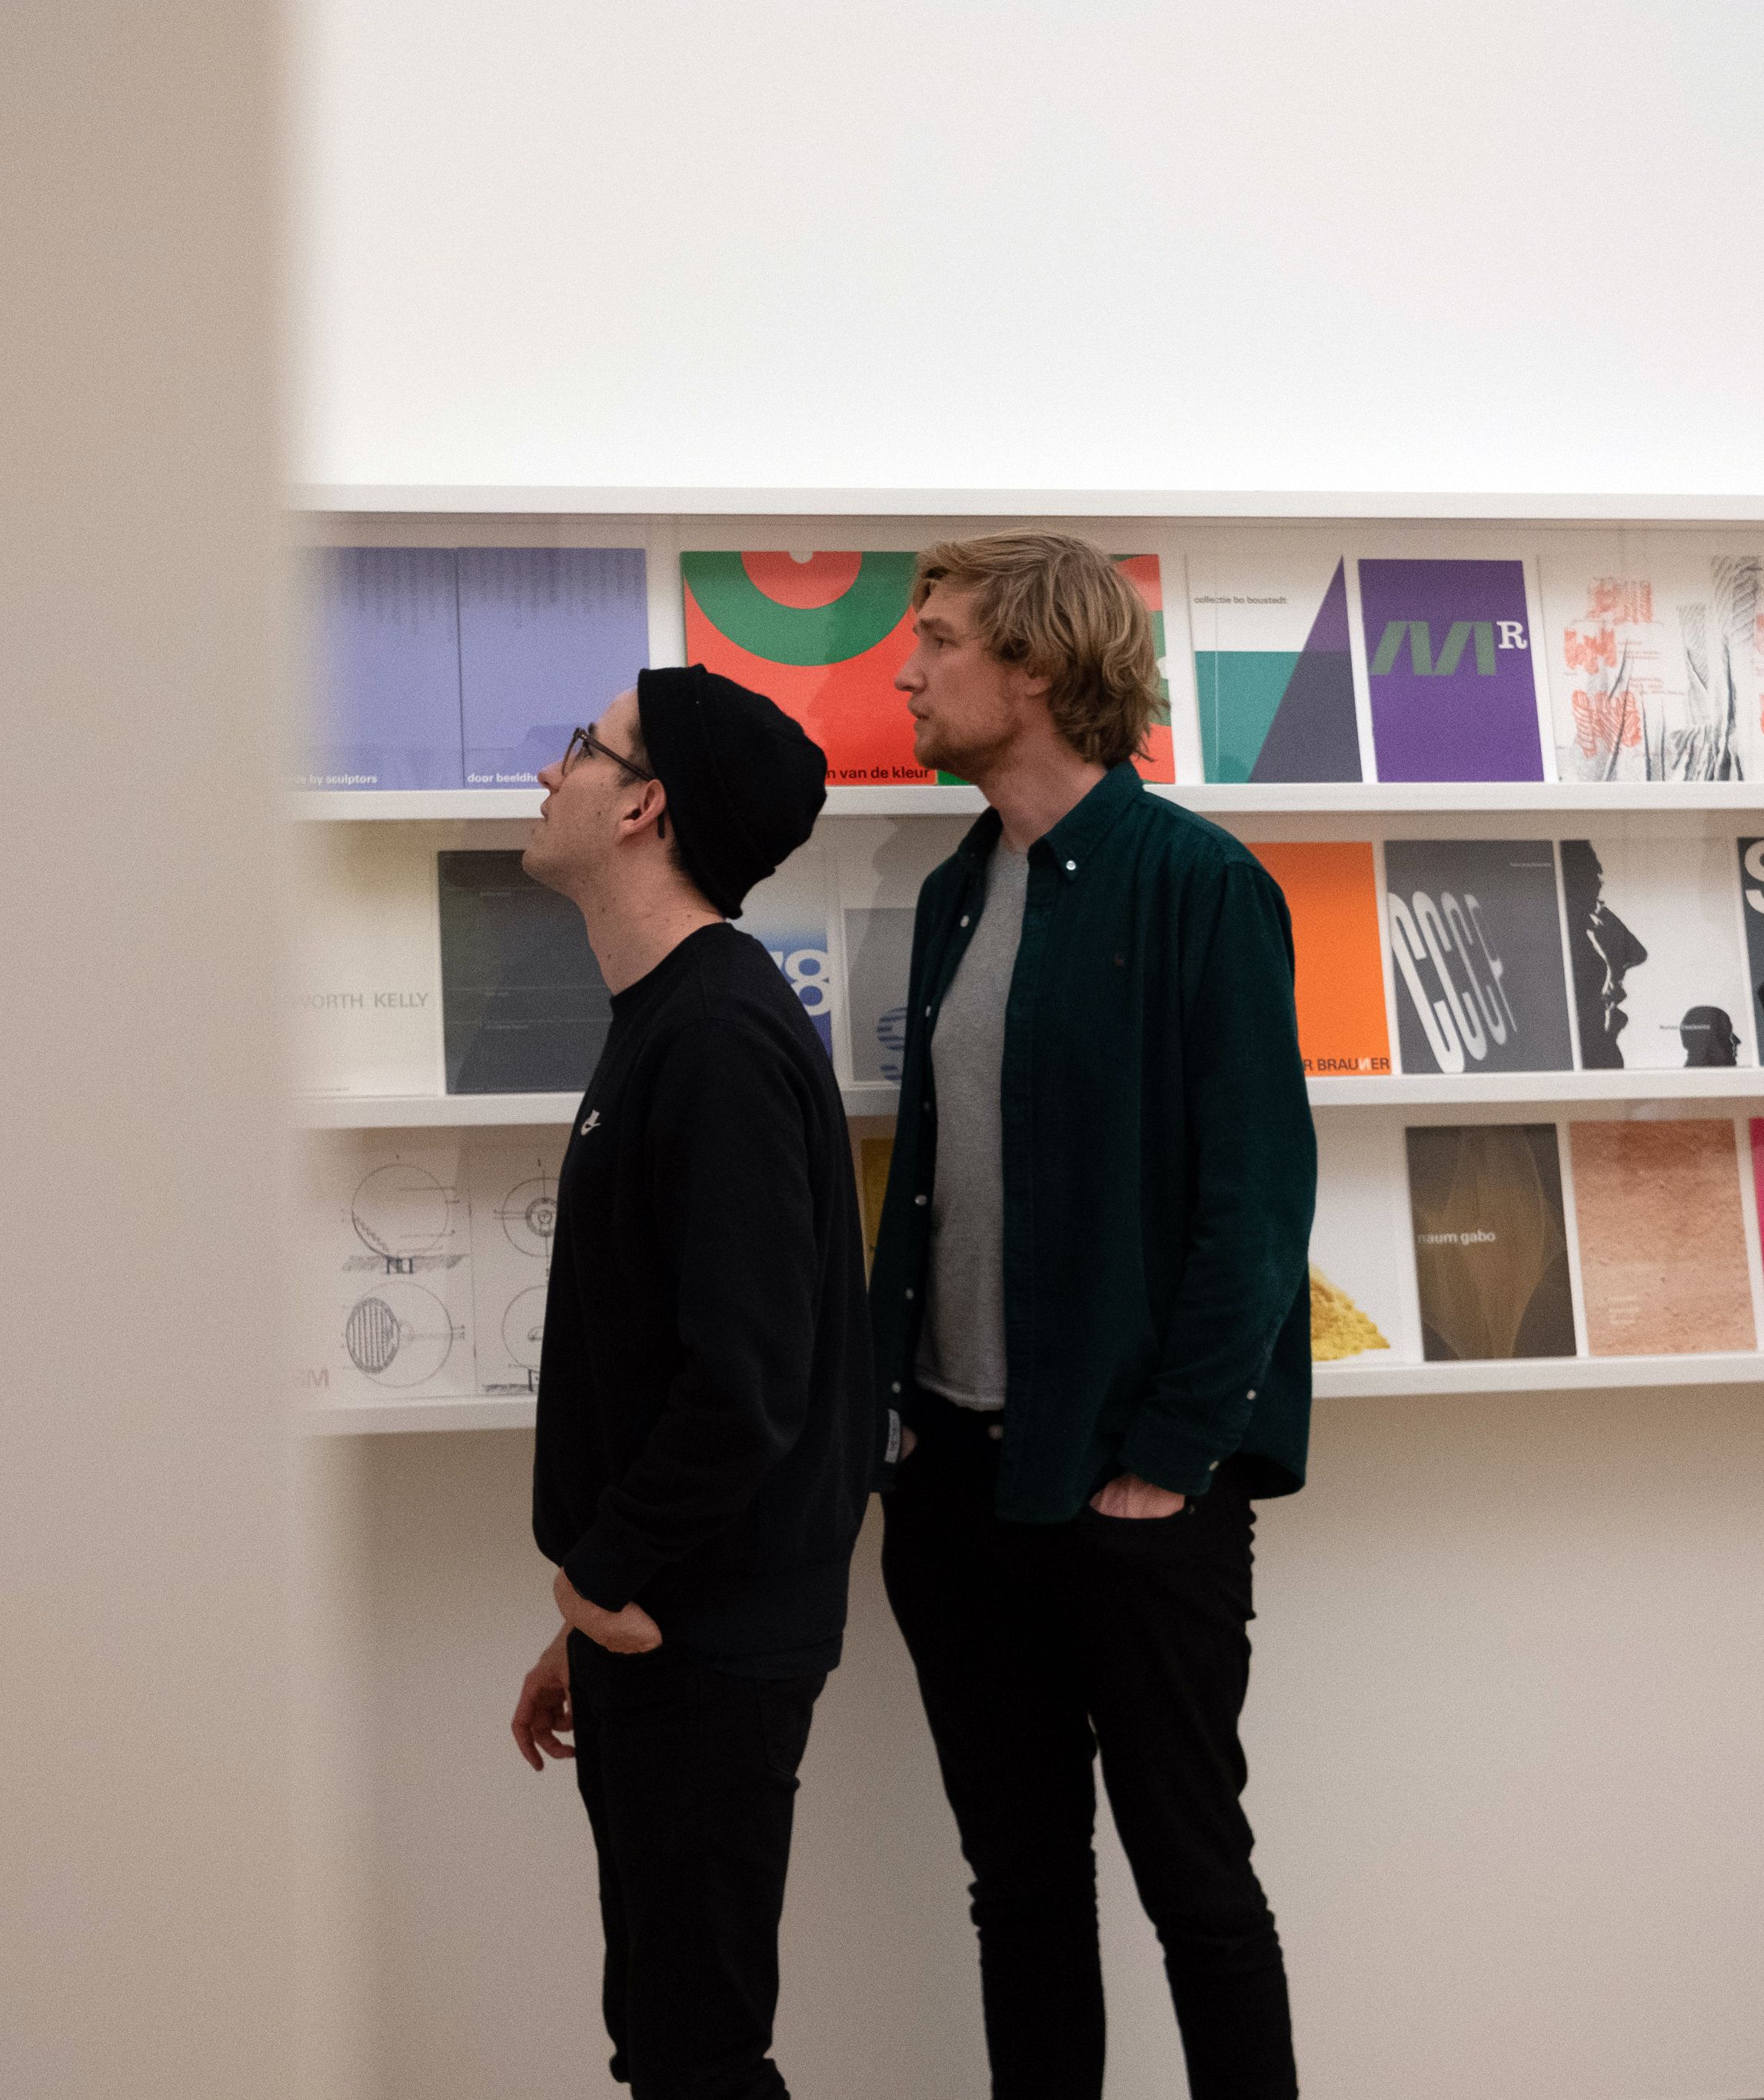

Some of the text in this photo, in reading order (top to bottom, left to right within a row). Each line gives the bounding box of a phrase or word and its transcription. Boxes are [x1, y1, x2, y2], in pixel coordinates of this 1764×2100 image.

[467, 773, 494, 783] door
[840, 770, 867, 779] van
[870, 767, 889, 779] de
[893, 767, 929, 779] kleur
[325, 774, 378, 786] sculptors
[374, 992, 430, 1008] KELLY
[1418, 1229, 1496, 1246] naum gabo
